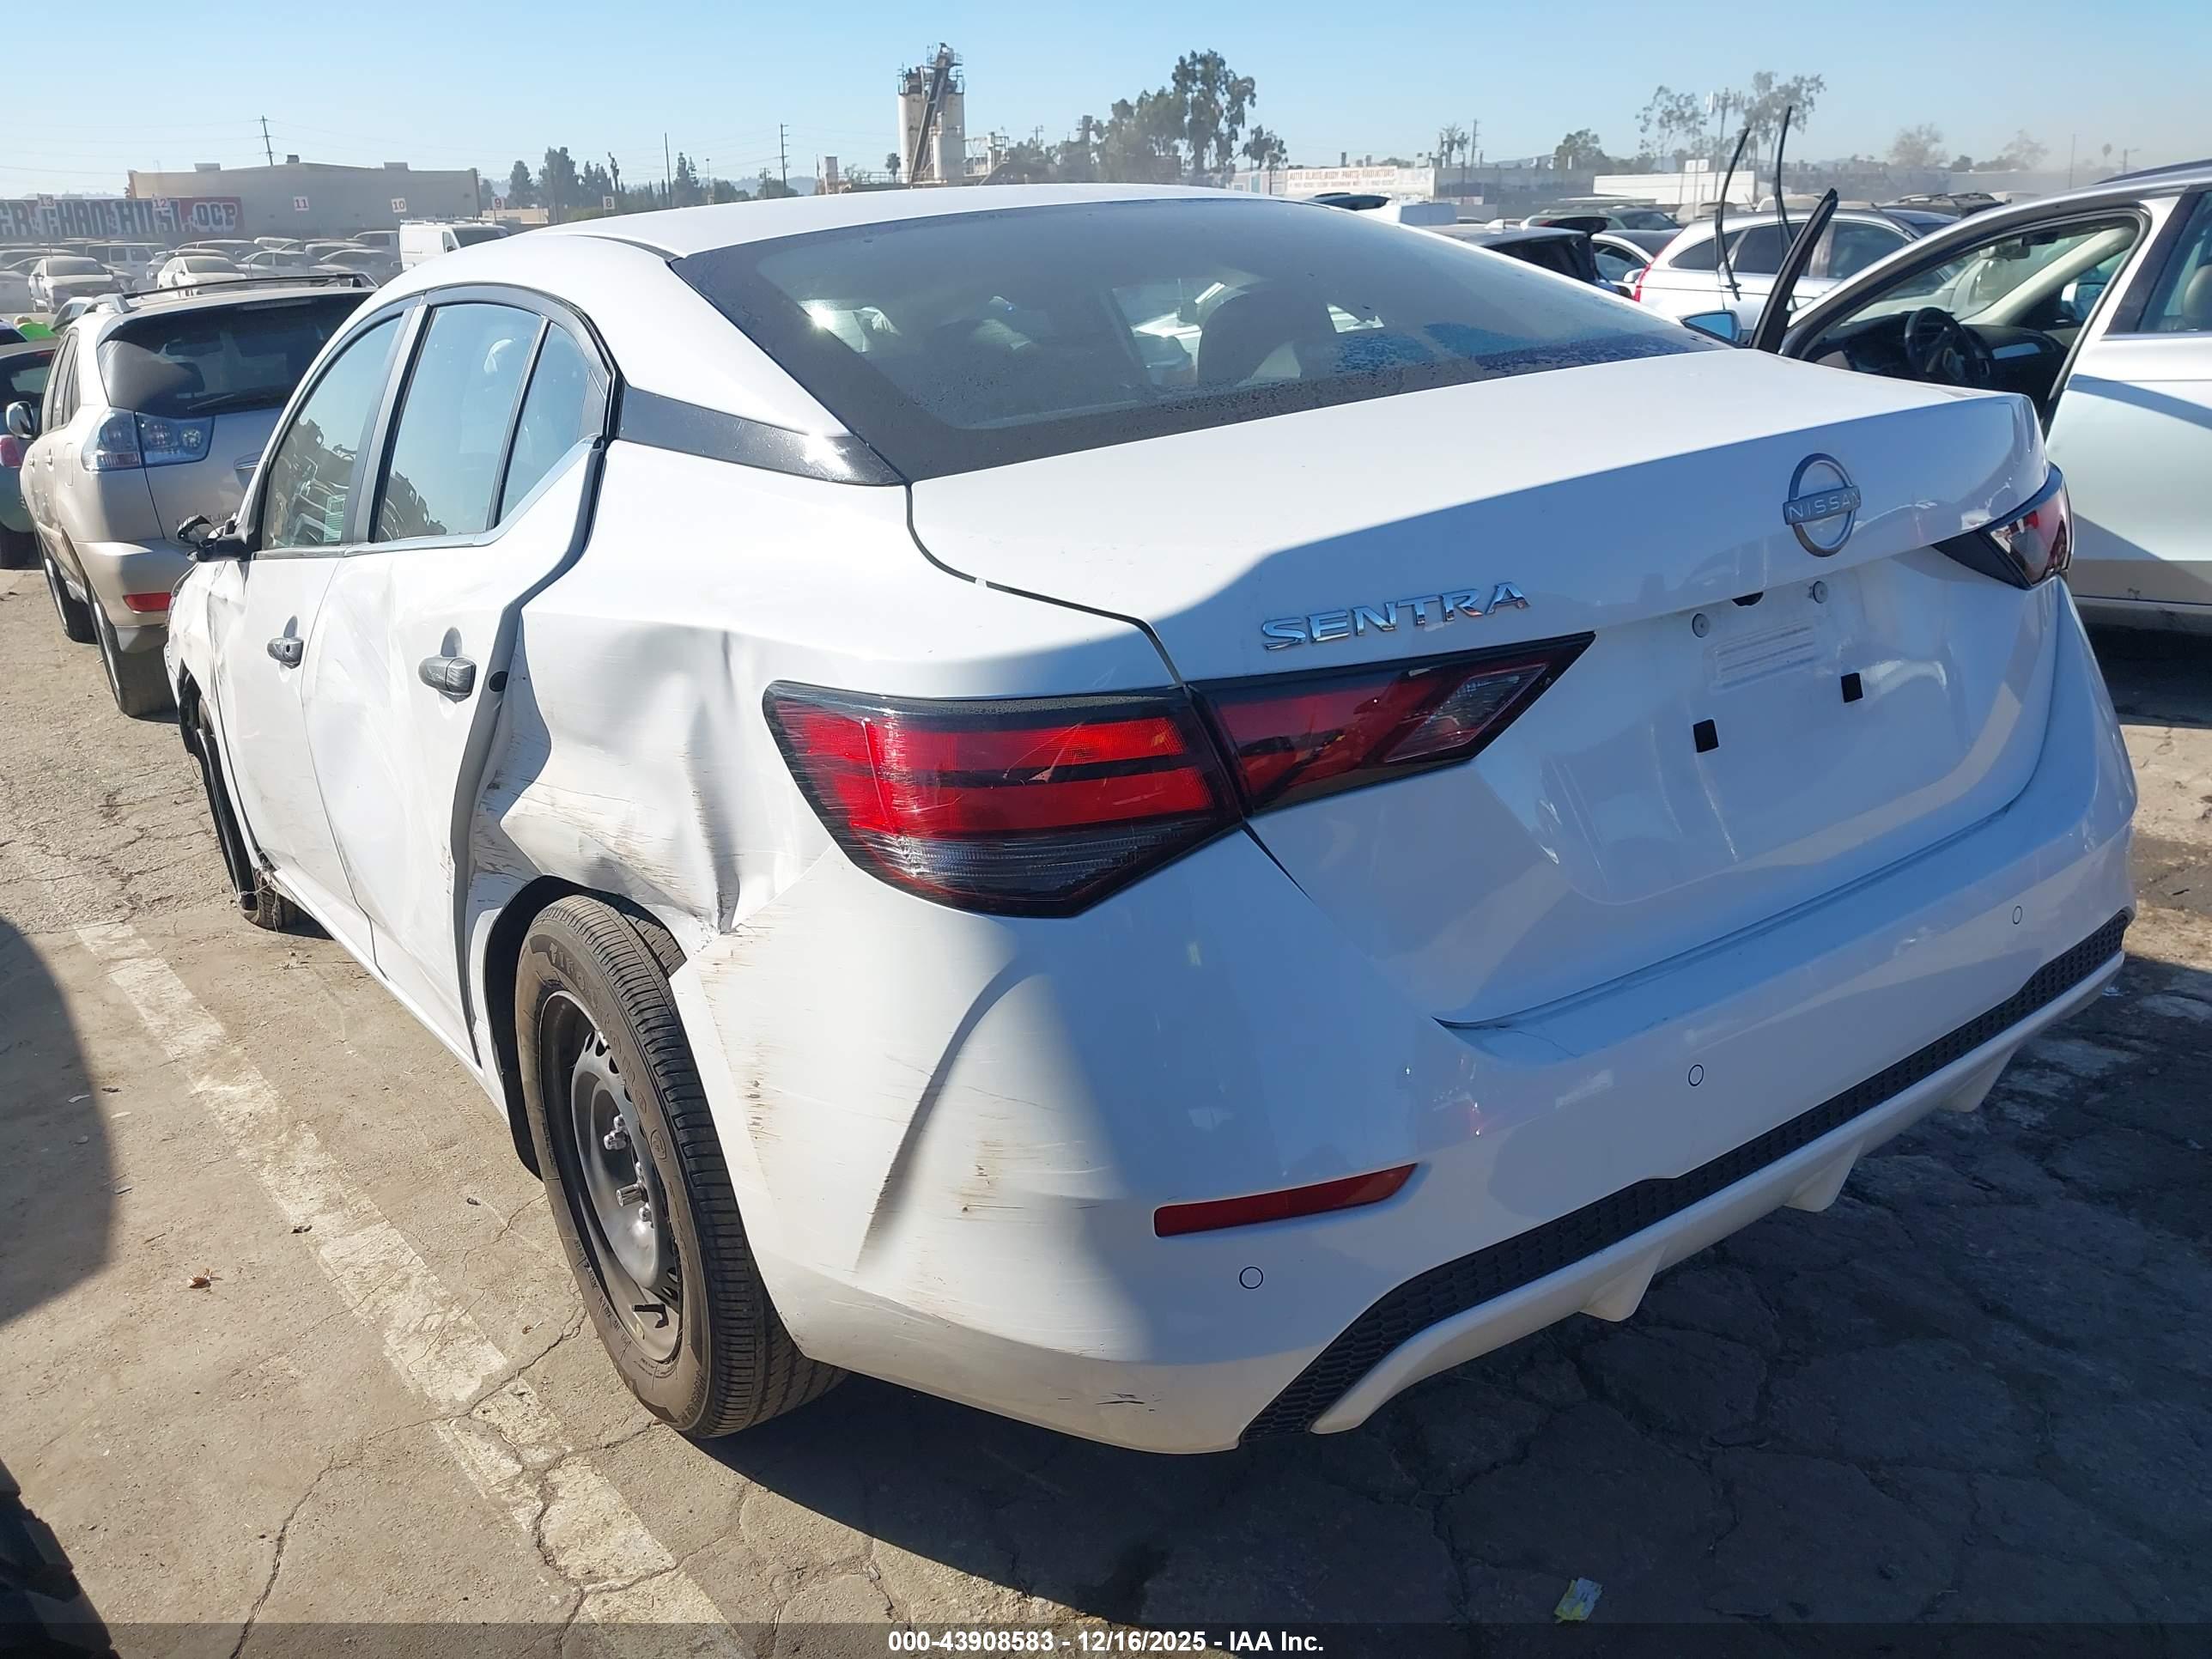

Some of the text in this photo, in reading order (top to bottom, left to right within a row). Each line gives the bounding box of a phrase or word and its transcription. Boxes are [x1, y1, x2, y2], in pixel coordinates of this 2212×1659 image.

[40, 196, 53, 207] 13
[155, 198, 167, 209] 12
[295, 198, 308, 209] 11
[392, 200, 405, 210] 10
[495, 198, 501, 208] 9
[1787, 492, 1861, 520] NISSAN
[1261, 580, 1530, 651] SENTRA
